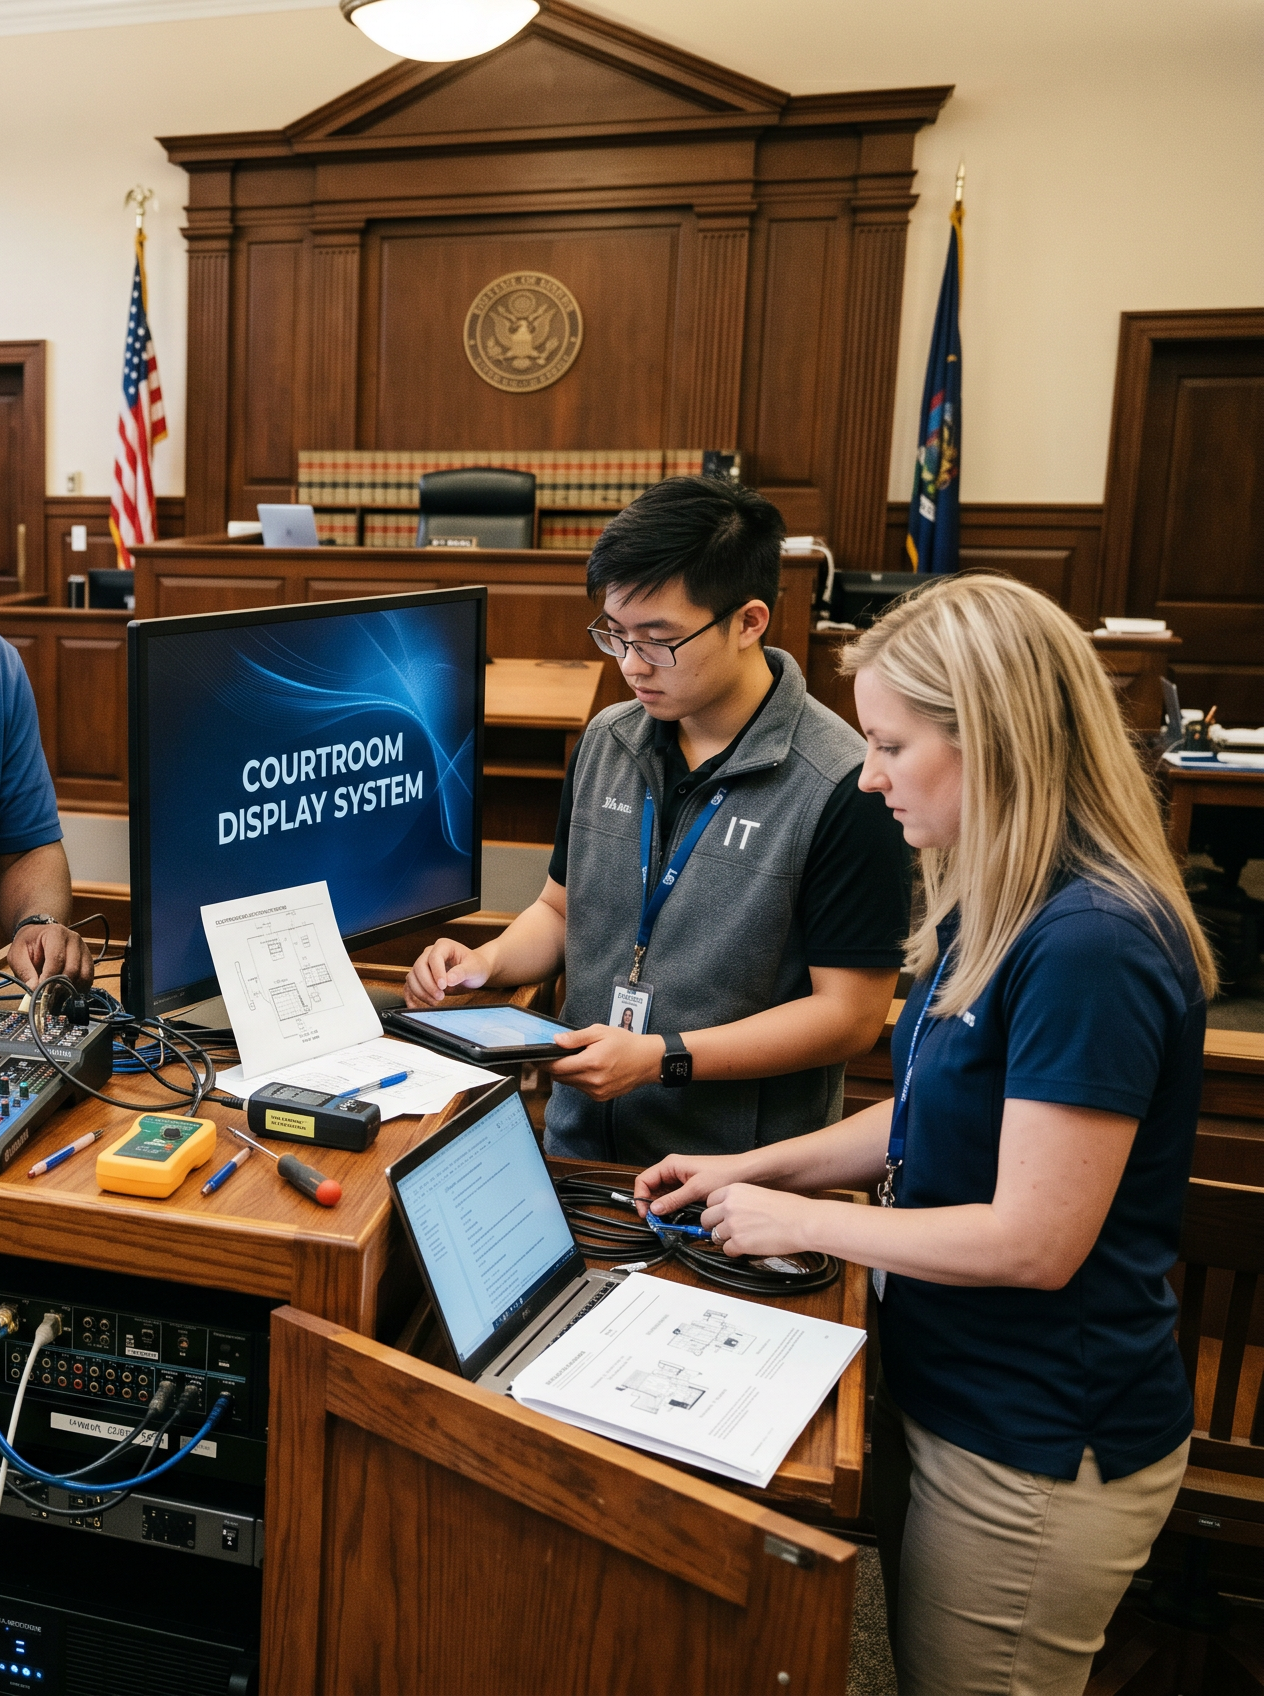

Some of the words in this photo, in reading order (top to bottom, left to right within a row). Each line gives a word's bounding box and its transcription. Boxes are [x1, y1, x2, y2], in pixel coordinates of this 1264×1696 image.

[242, 732, 403, 793] COURTROOM
[218, 791, 328, 845] DISPLAY
[334, 770, 423, 818] SYSTEM
[723, 816, 761, 850] IT
